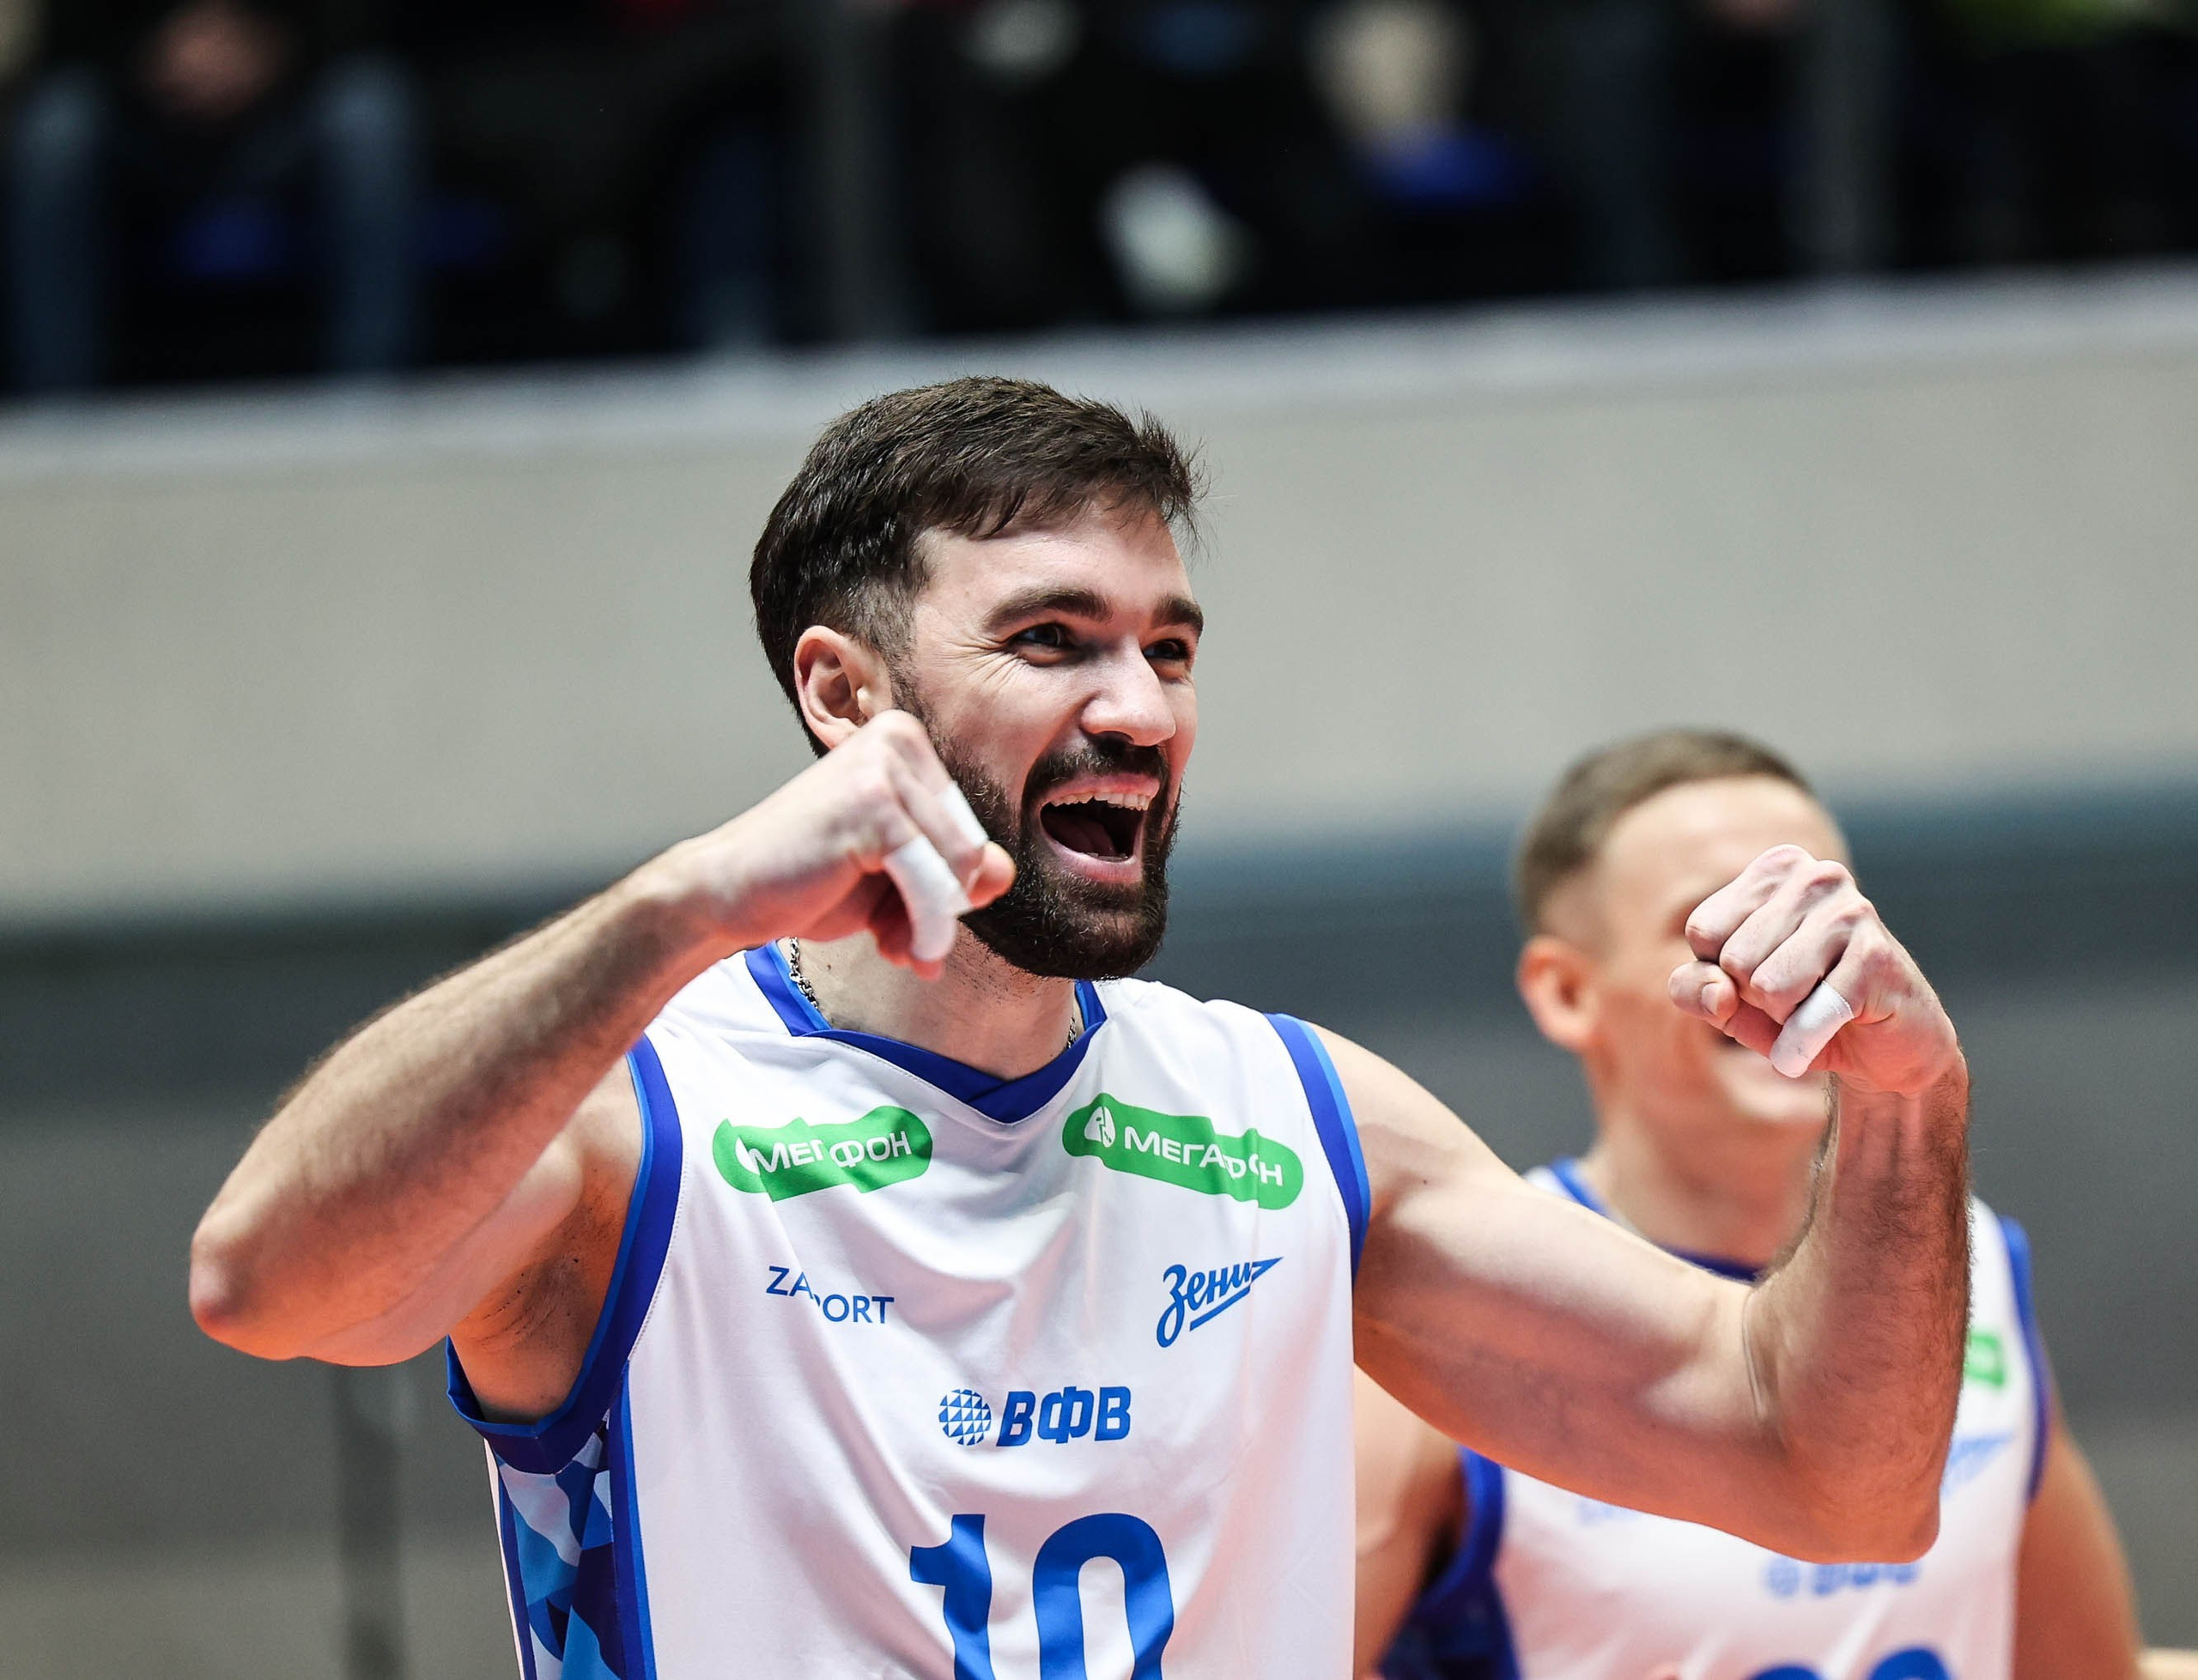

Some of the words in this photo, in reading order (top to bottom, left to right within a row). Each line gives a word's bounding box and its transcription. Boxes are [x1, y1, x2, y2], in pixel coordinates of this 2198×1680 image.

[749, 1130, 912, 1174] МЕГФОН
[766, 1265, 895, 1324] ZAORT
[996, 1386, 1132, 1447] ВФВ
[909, 1513, 1175, 1680] 10
